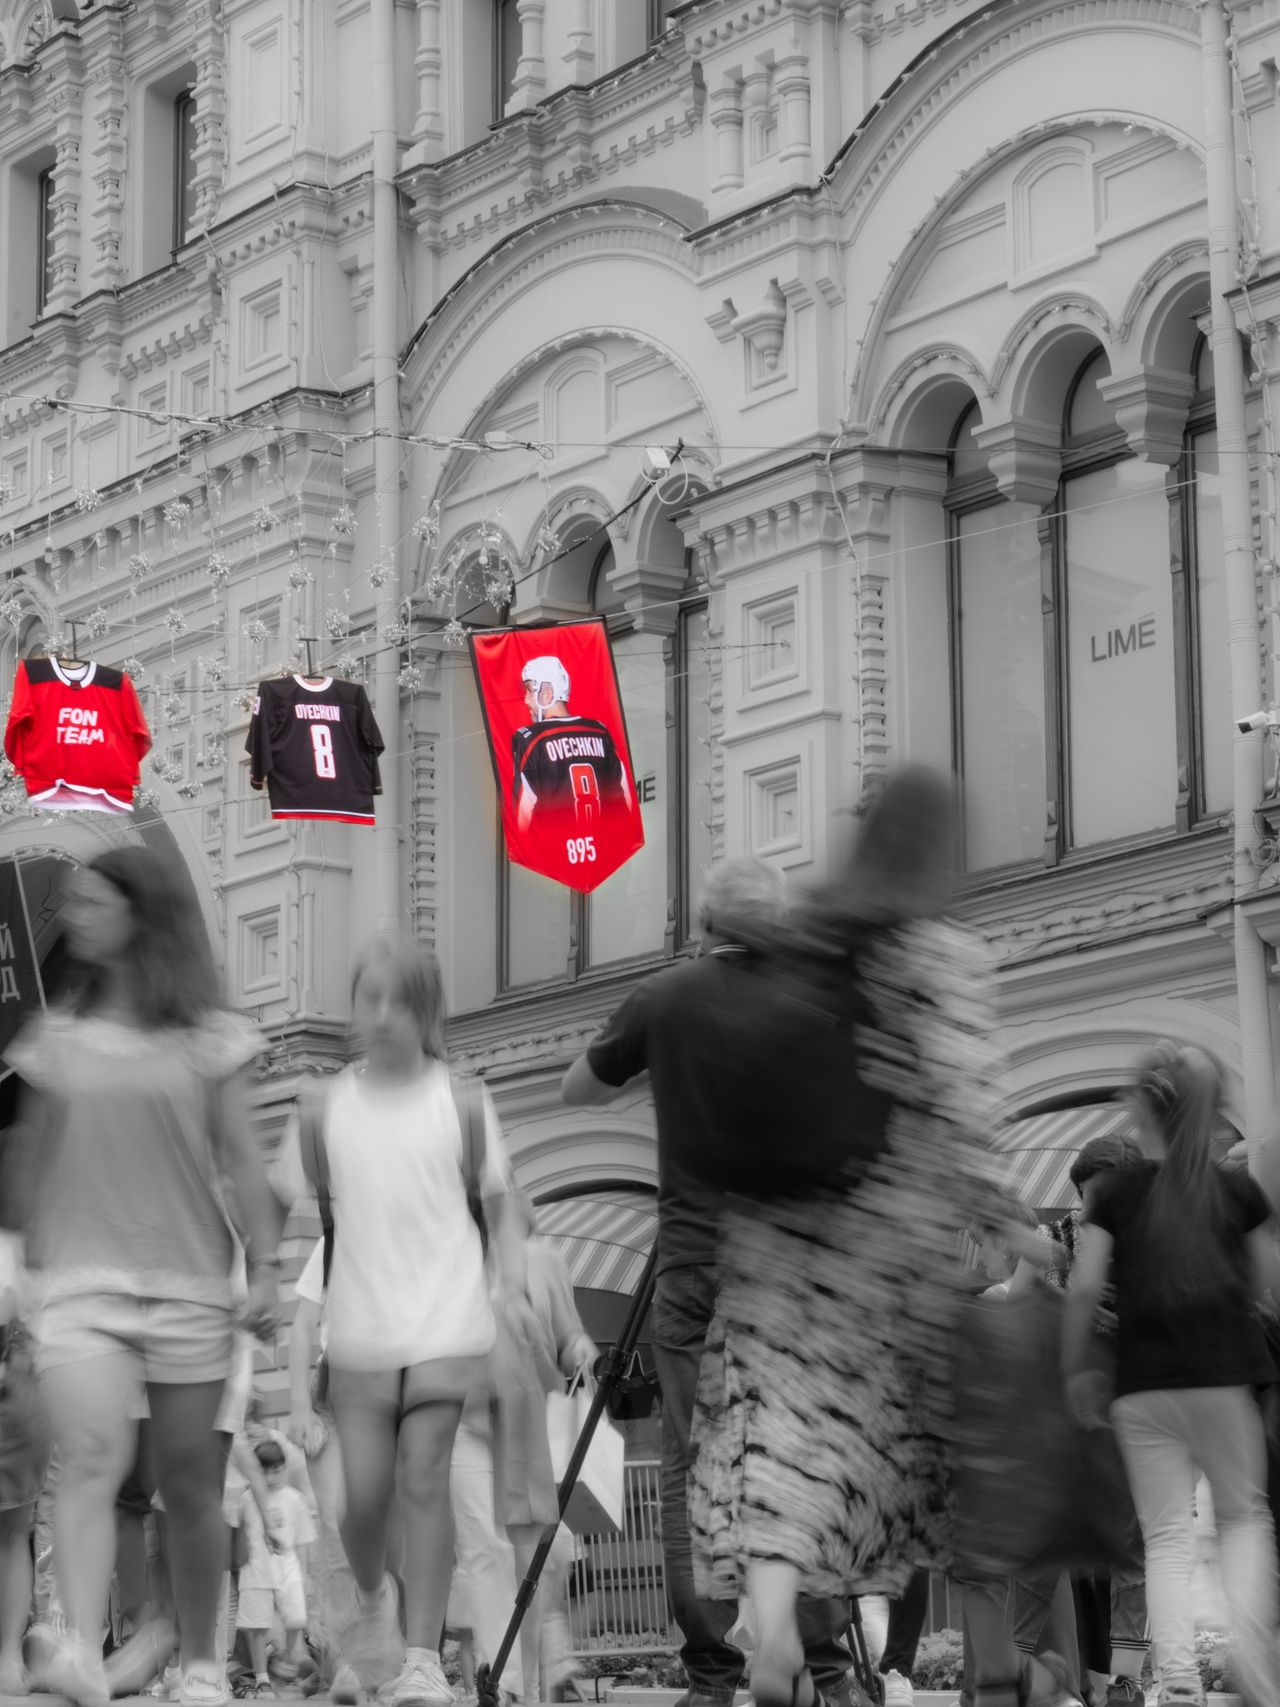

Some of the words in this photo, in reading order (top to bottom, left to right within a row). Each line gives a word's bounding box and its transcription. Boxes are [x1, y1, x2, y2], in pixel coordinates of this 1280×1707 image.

[58, 707, 98, 727] FON
[294, 703, 341, 722] OVECHKIN
[56, 726, 104, 745] TEAM
[310, 724, 337, 779] 8
[545, 737, 605, 762] OVECHKIN
[568, 763, 601, 823] 8
[566, 836, 597, 865] 895
